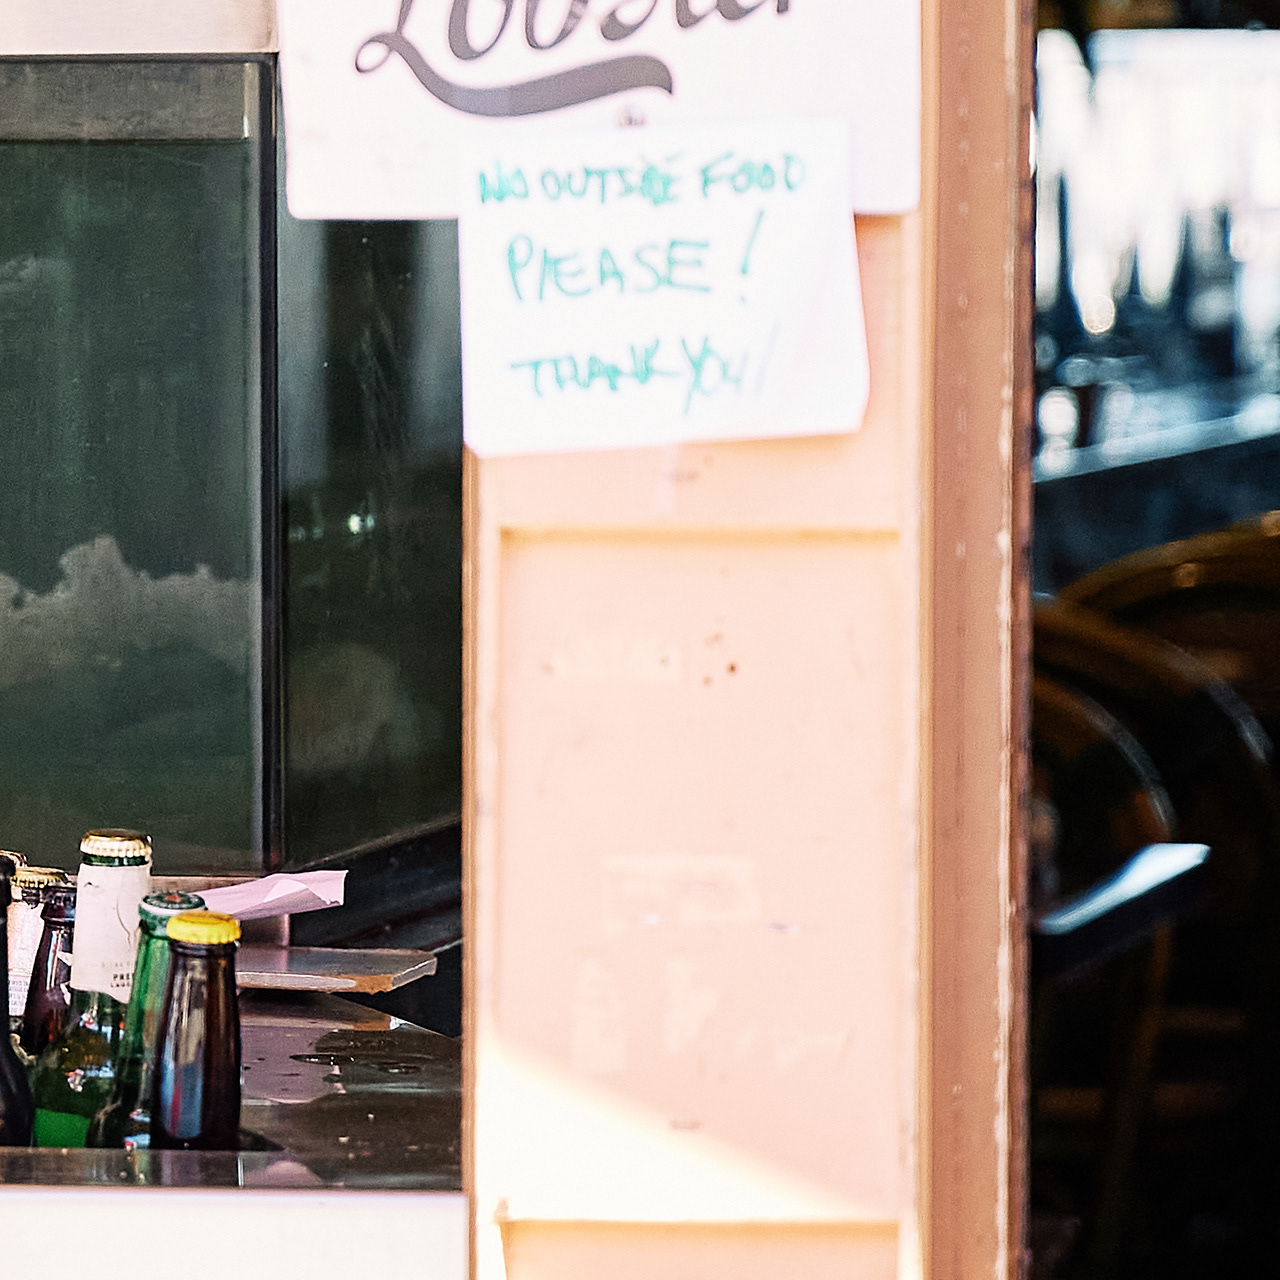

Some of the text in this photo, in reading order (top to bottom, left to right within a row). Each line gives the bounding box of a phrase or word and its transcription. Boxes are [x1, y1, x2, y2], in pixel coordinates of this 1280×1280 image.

[478, 160, 529, 204] NO
[700, 151, 806, 197] FOOD
[510, 337, 681, 398] THANK
